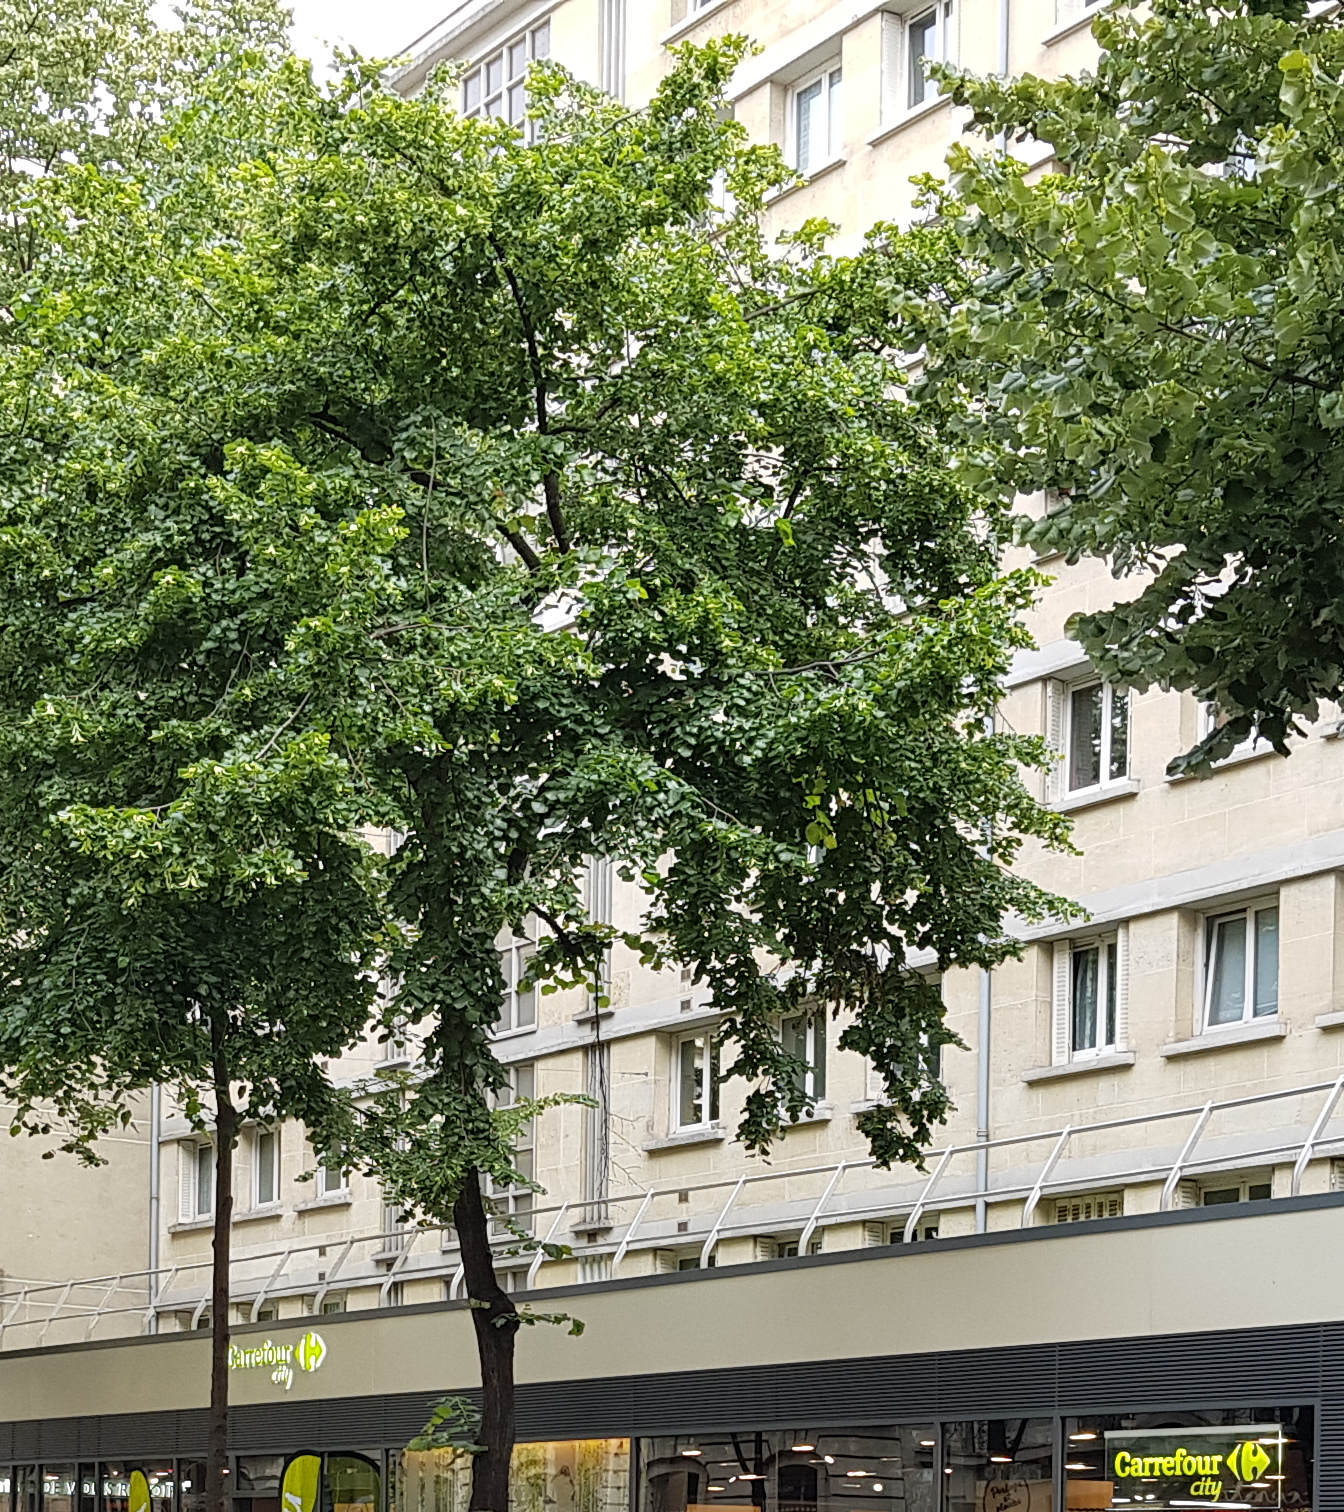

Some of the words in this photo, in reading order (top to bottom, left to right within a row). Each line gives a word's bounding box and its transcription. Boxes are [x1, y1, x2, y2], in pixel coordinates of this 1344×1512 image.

[228, 1340, 293, 1369] Carrefour
[271, 1365, 293, 1390] city
[1114, 1448, 1223, 1477] Carrefour
[1189, 1477, 1223, 1502] city
